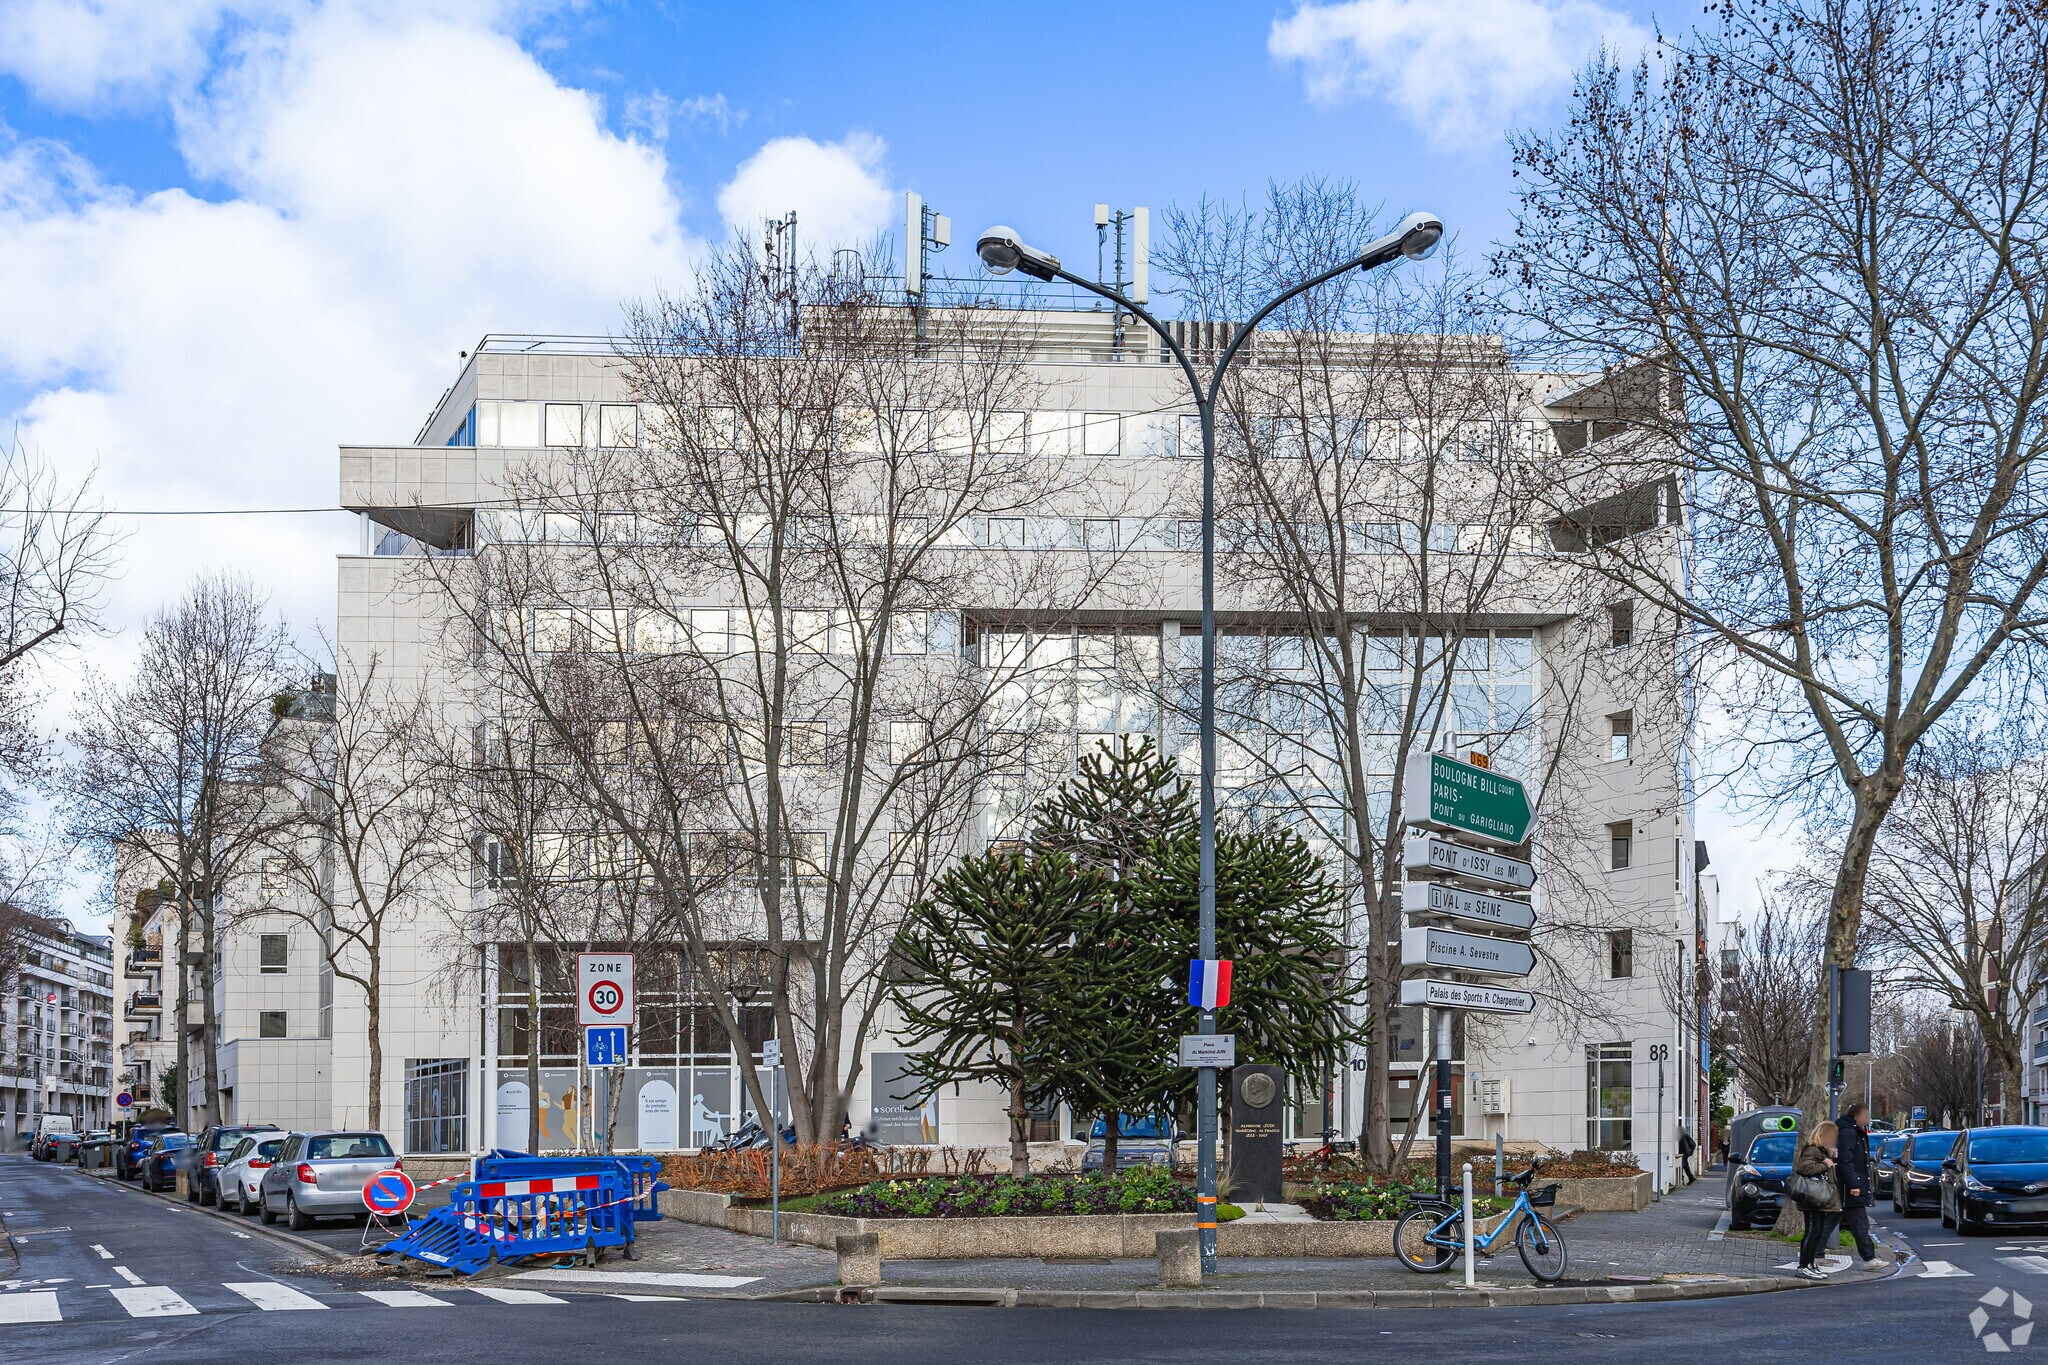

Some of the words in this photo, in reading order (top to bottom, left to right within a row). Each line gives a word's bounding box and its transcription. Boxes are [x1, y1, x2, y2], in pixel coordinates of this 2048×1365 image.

[1434, 762, 1477, 789] BOULOGNE
[1434, 802, 1454, 818] PONT
[1458, 813, 1465, 821] DU
[1470, 814, 1514, 836] GARIGLIANO
[1433, 847, 1458, 864] PONT
[1495, 866, 1504, 876] LES
[1443, 894, 1459, 910] VAL
[1464, 902, 1471, 911] DE
[1476, 900, 1501, 917] SEINE
[1430, 941, 1456, 955] Piscine
[1460, 945, 1466, 957] A.
[1470, 947, 1500, 961] Sevestre
[590, 963, 622, 972] ZONE
[596, 990, 617, 1005] 30
[1430, 986, 1448, 1000] Palais
[1450, 989, 1461, 1000] des
[1463, 990, 1482, 1004] Sports
[1485, 993, 1491, 1002] R.
[1492, 993, 1525, 1007] Charpentier
[1650, 1044, 1668, 1061] 88
[1350, 1059, 1366, 1072] 10
